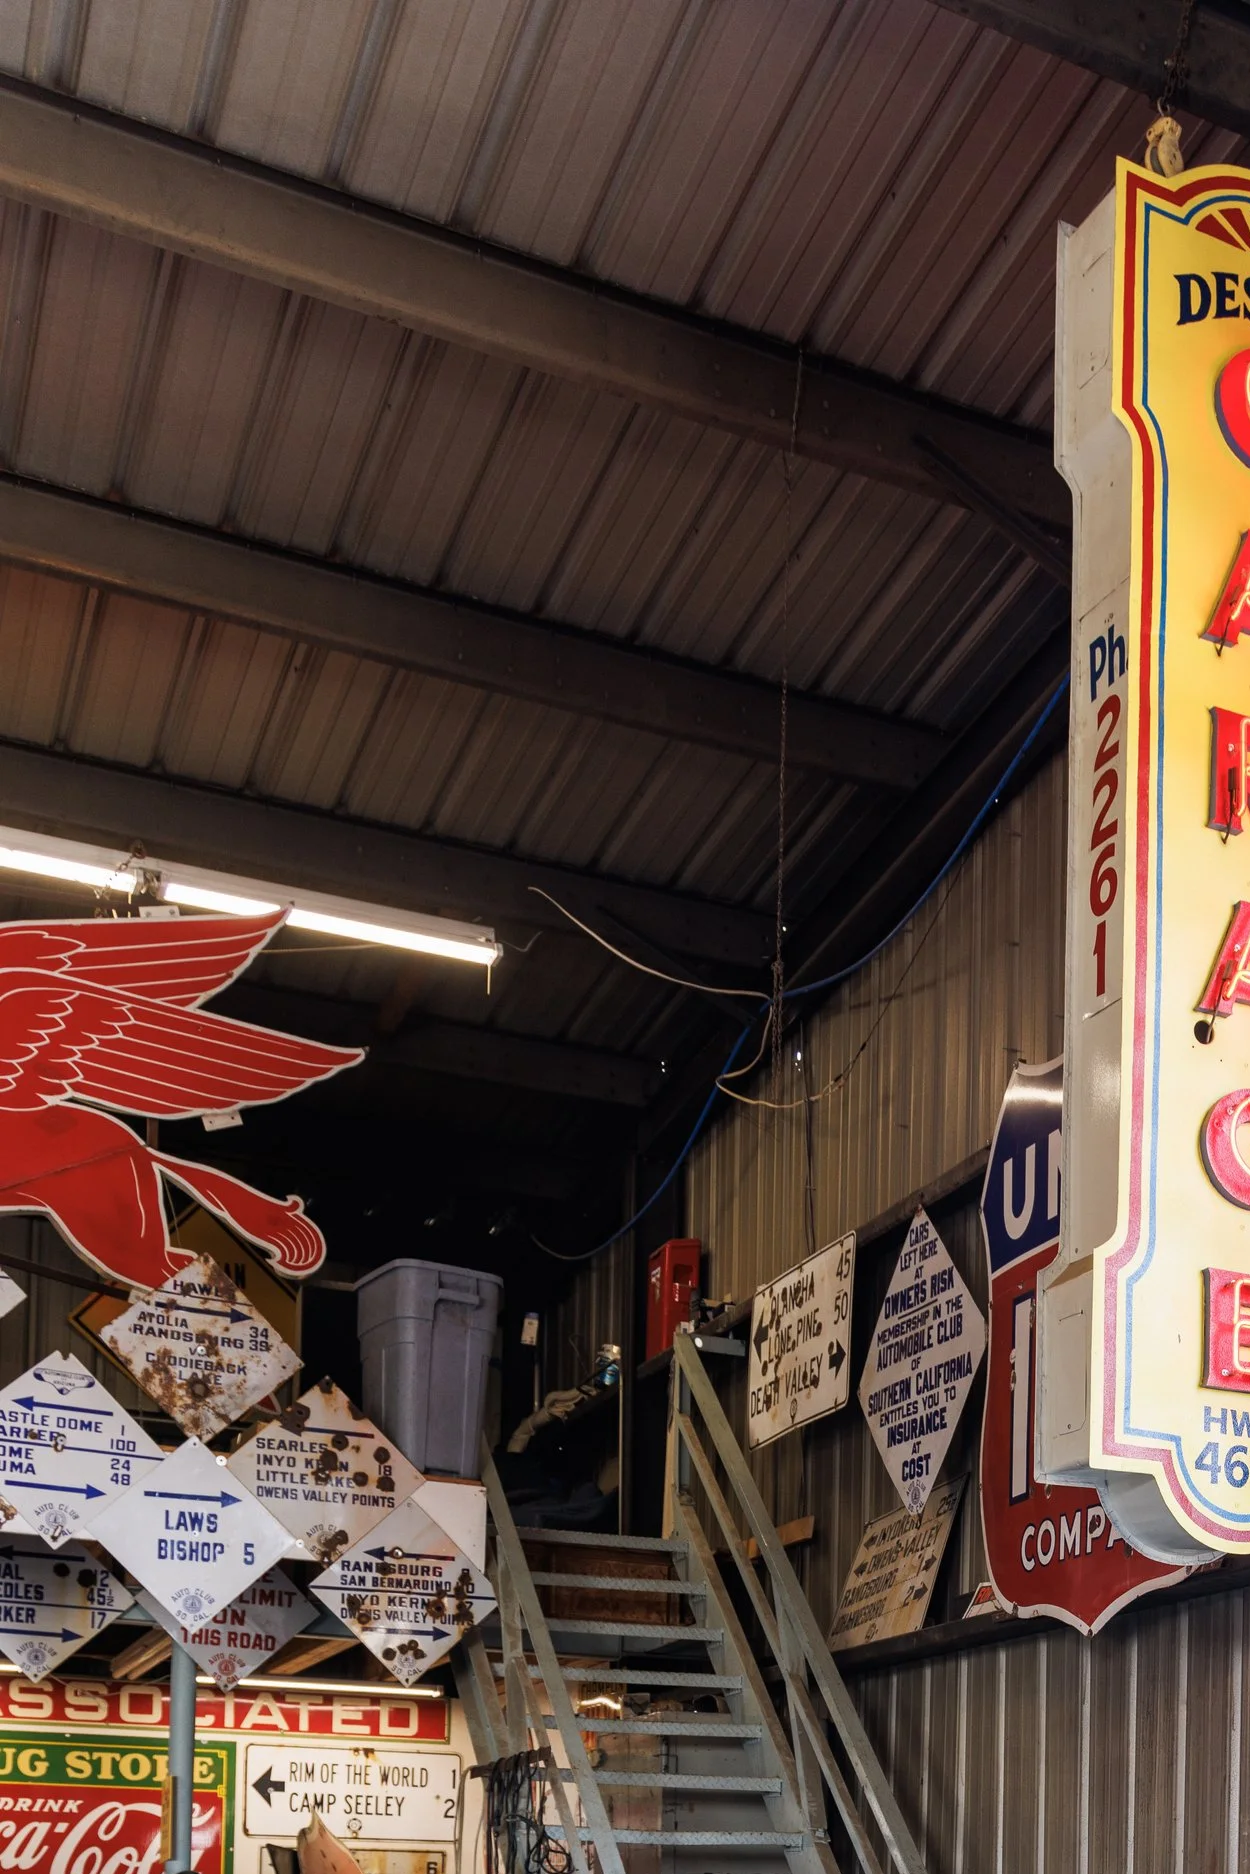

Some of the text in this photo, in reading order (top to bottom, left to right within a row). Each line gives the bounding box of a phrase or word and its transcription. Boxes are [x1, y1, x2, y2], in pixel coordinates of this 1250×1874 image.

[1088, 695, 1121, 998] 2261
[910, 1221, 929, 1247] CARS
[900, 1238, 938, 1272] LEFT HERE
[836, 1249, 851, 1282] 45
[914, 1266, 924, 1281] AT
[885, 1266, 954, 1320] OWNERS RISK
[834, 1291, 849, 1325] 50
[138, 1311, 189, 1329] ATOLIA
[877, 1294, 963, 1347] MEMBERSHIP IN THE
[132, 1324, 270, 1352] RANDSRG 39
[249, 1326, 269, 1340] 34
[768, 1308, 820, 1364] LONE PINE
[878, 1313, 963, 1371] AUTOMOBILE CLUB
[911, 1357, 921, 1370] OF
[785, 1353, 823, 1398] VALLEY
[868, 1352, 972, 1417] SOUTHERN CALIFORNIA
[880, 1385, 956, 1428] ENTITLES YOU TO
[56, 1416, 103, 1434] DOME
[887, 1407, 947, 1448] INSURANCE
[109, 1438, 136, 1453] 100
[256, 1437, 328, 1454] SEARLES
[912, 1441, 922, 1455] AT
[110, 1458, 131, 1471] 24
[256, 1453, 392, 1477] INYO KEN 18
[902, 1453, 931, 1482] COST
[110, 1472, 131, 1486] 48
[256, 1469, 309, 1486] LITTLE
[256, 1486, 395, 1509] OWENS VALLEY POINTS
[34, 1503, 80, 1521] AUTO CLUB
[165, 1510, 218, 1533] LAWS
[37, 1524, 50, 1536] SO
[305, 1523, 324, 1538] AUTO
[902, 1523, 942, 1559] VALLEY
[157, 1539, 255, 1565] BISHOP 5
[341, 1559, 443, 1578] RANSBURG
[340, 1574, 366, 1587] SAN
[372, 1576, 451, 1593] BERNARDINO
[171, 1588, 215, 1605] AUTO CLUB
[239, 1588, 297, 1608] LIMIT
[91, 1611, 107, 1629] 17
[175, 1608, 187, 1620] SO
[385, 1609, 428, 1624] VALLEY
[16, 1641, 58, 1657] AUTO CLUB
[227, 1630, 277, 1653] ROAD
[21, 1661, 51, 1673] SO CAL
[208, 1652, 246, 1668] AUTO CLUB
[212, 1671, 241, 1683] SO CAL
[391, 1665, 423, 1677] SO CAL
[0, 1678, 418, 1737] SSOCIATED
[289, 1761, 315, 1783] RIM
[320, 1763, 339, 1784] OF
[346, 1764, 371, 1786] THE
[379, 1766, 429, 1788] WORLD
[0, 1797, 84, 1814] DRINK
[288, 1793, 456, 1819] CAMP SEELEY 2
